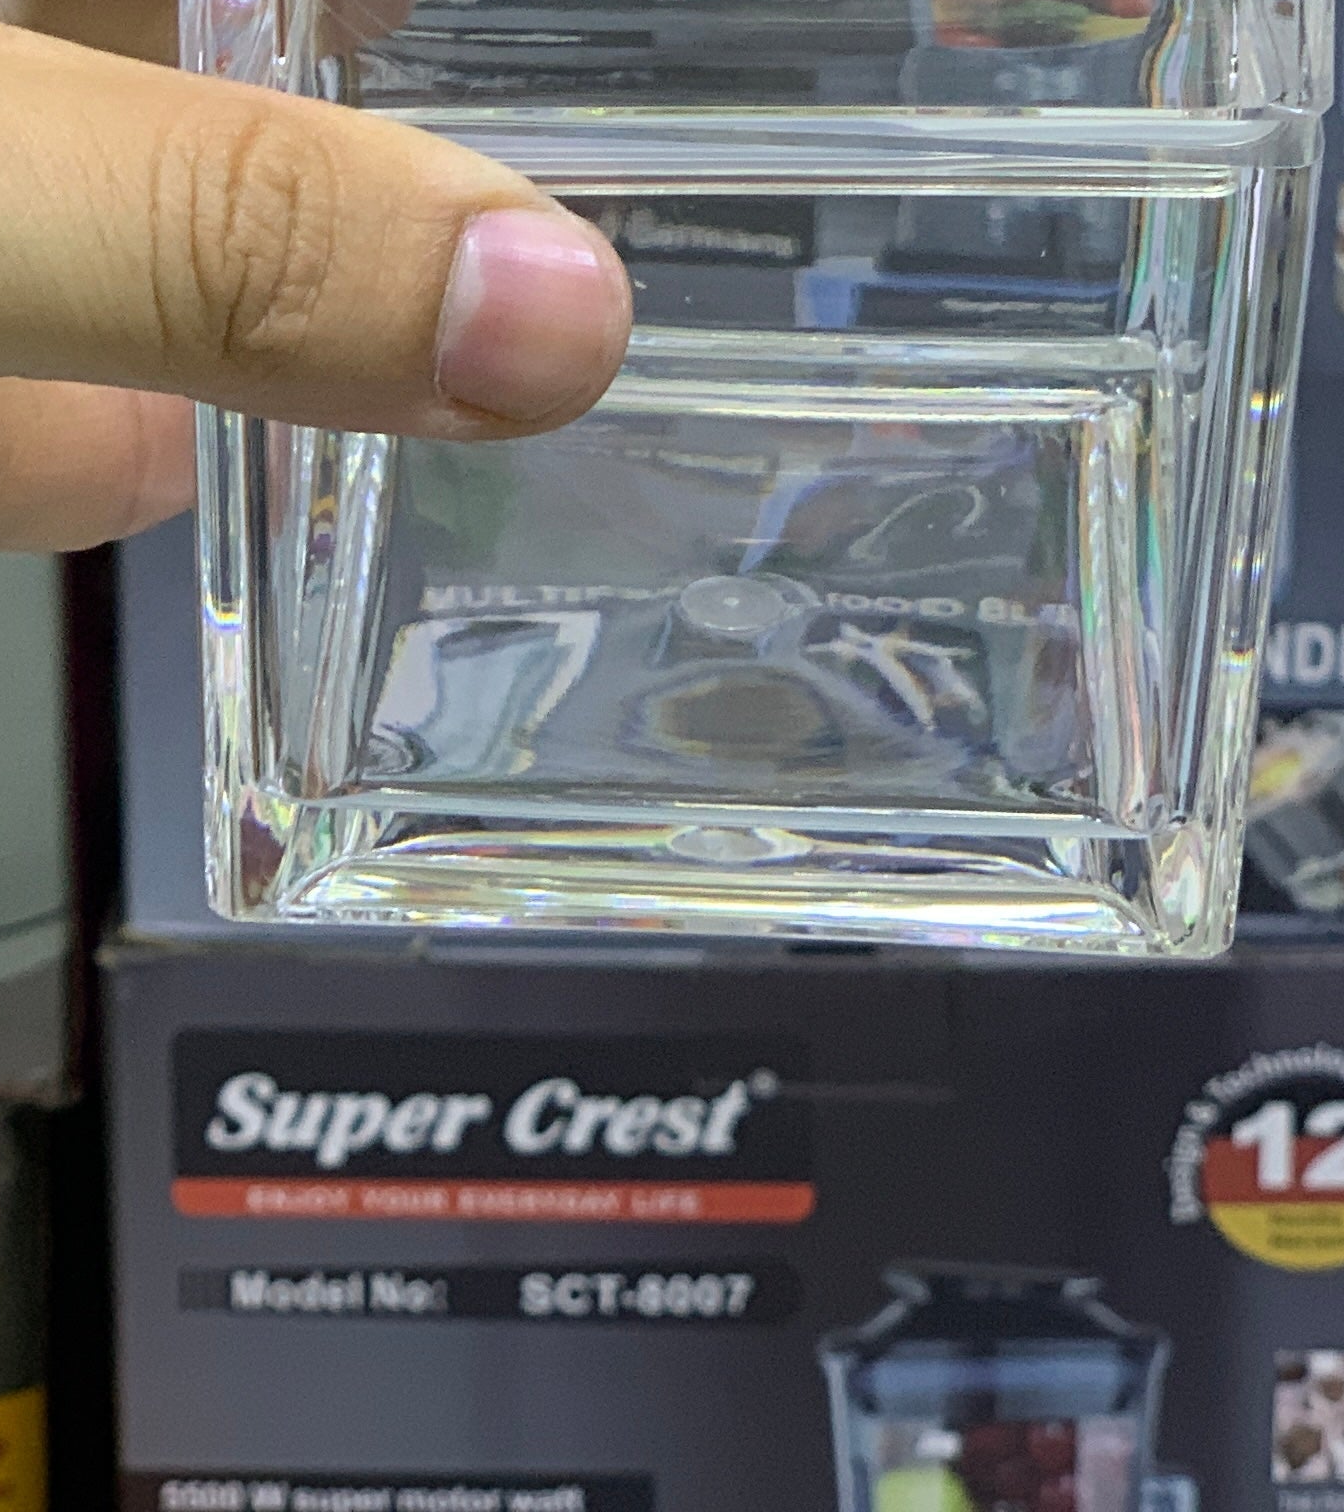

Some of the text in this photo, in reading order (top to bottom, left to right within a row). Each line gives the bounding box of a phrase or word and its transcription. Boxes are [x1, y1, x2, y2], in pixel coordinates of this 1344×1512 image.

[205, 1070, 749, 1170] Super Crest
[229, 1271, 365, 1311] Model
